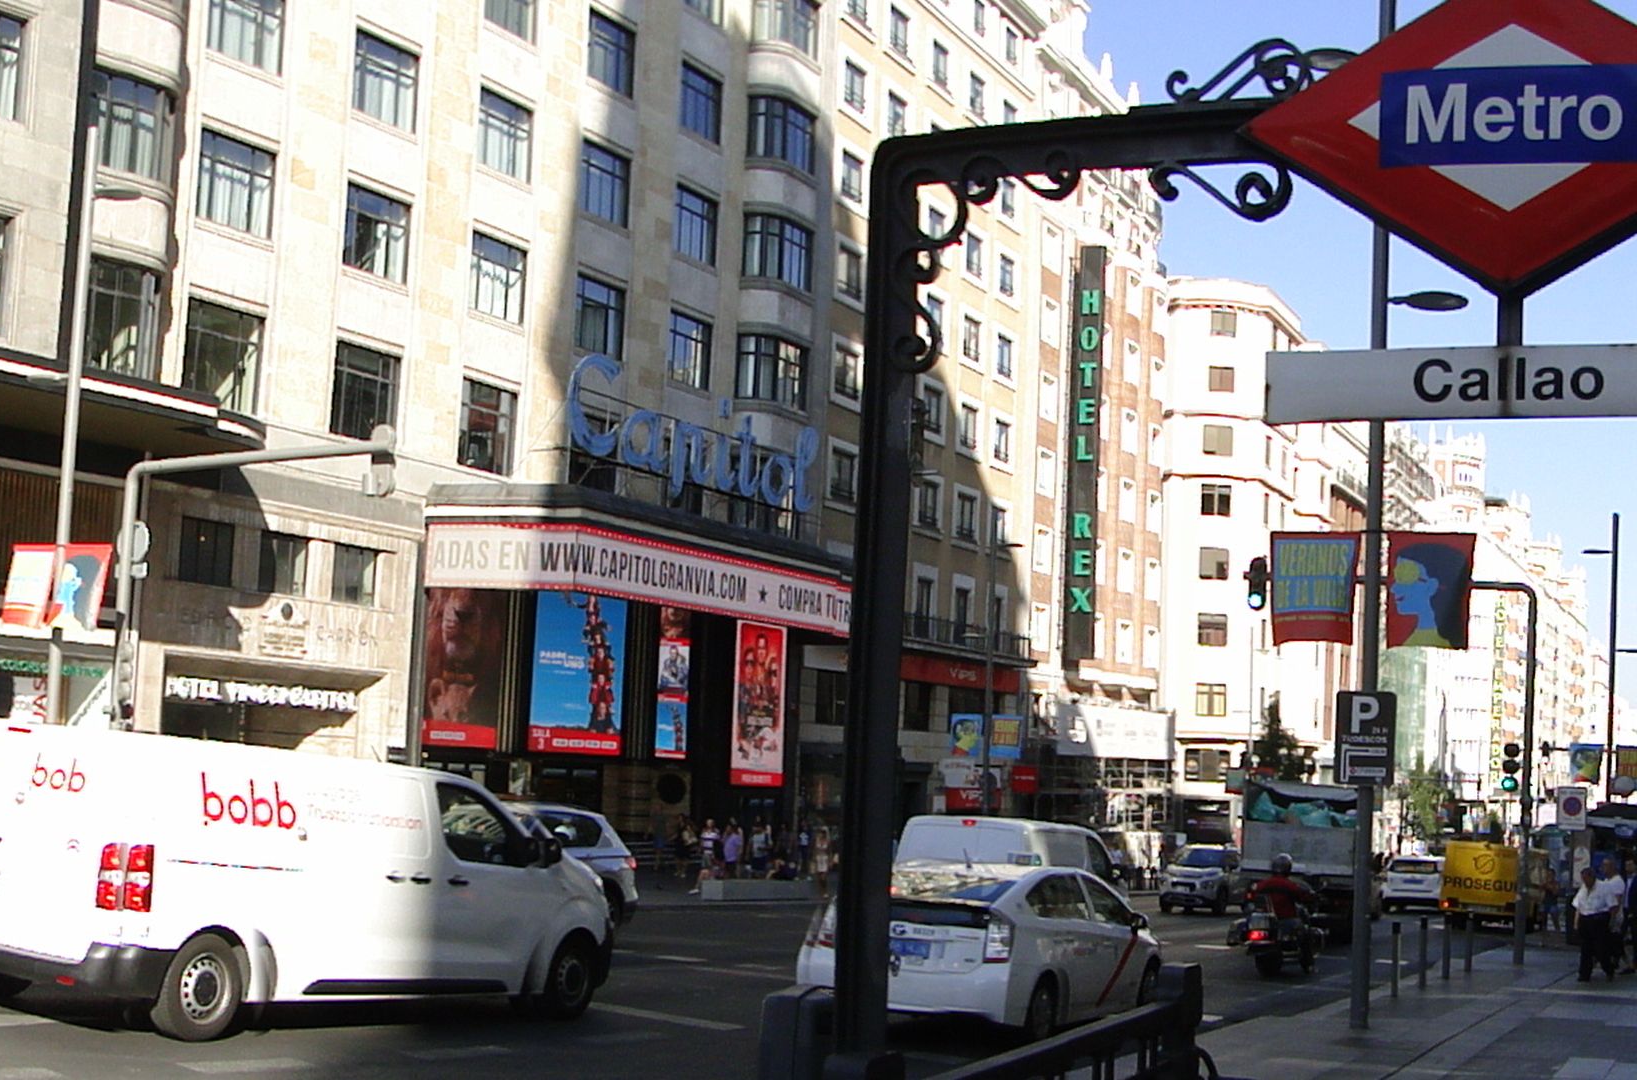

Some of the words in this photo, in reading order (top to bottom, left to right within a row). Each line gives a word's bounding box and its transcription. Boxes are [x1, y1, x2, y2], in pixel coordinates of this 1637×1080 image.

[1404, 83, 1624, 144] Metro
[1076, 289, 1100, 460] HOTEL
[1412, 356, 1605, 402] Callao
[565, 352, 821, 512] Capitol
[432, 539, 490, 570] ADAS
[498, 540, 530, 571] EN
[540, 541, 748, 603] WWW.CAPITOLGRANVIA.COM
[777, 584, 823, 611] COMPRA
[1069, 512, 1094, 613] REX
[0, 658, 39, 672] COLORS
[164, 676, 223, 700] HOTEL
[1350, 695, 1380, 734] P
[201, 771, 297, 830] bobb
